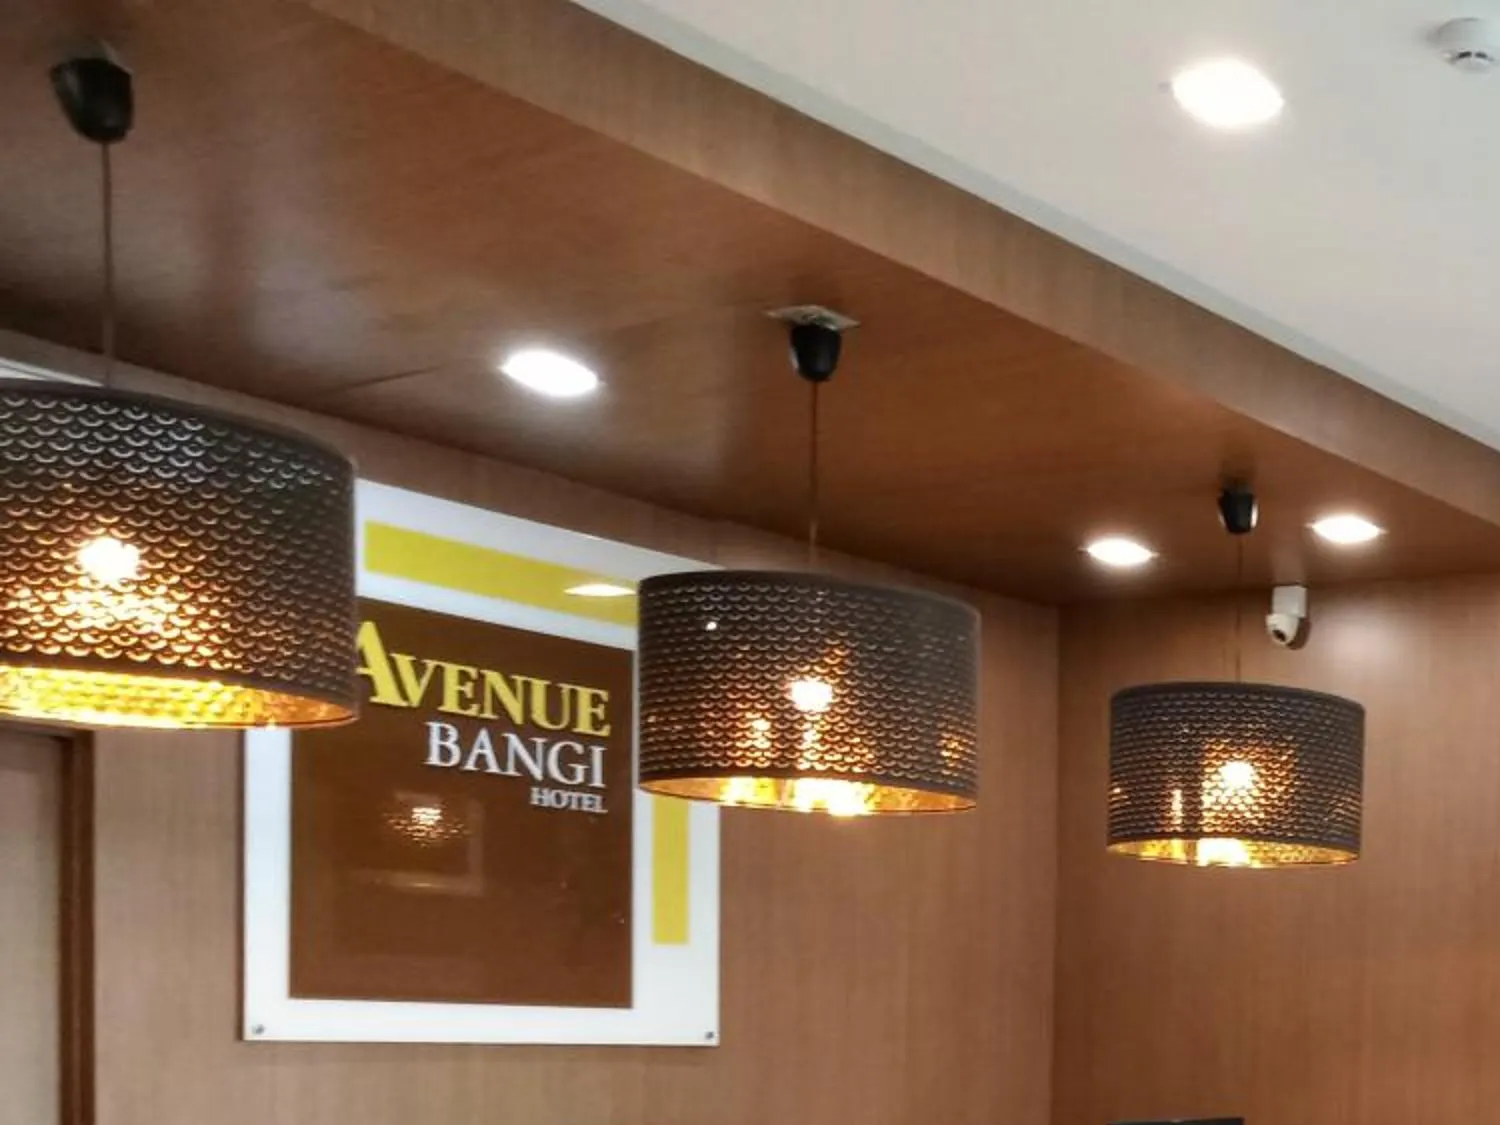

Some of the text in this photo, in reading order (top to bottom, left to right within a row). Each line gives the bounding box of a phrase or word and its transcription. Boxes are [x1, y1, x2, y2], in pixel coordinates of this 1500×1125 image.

[355, 620, 612, 737] AVENUE
[424, 720, 607, 788] BANGI
[529, 786, 609, 813] HOTEL
